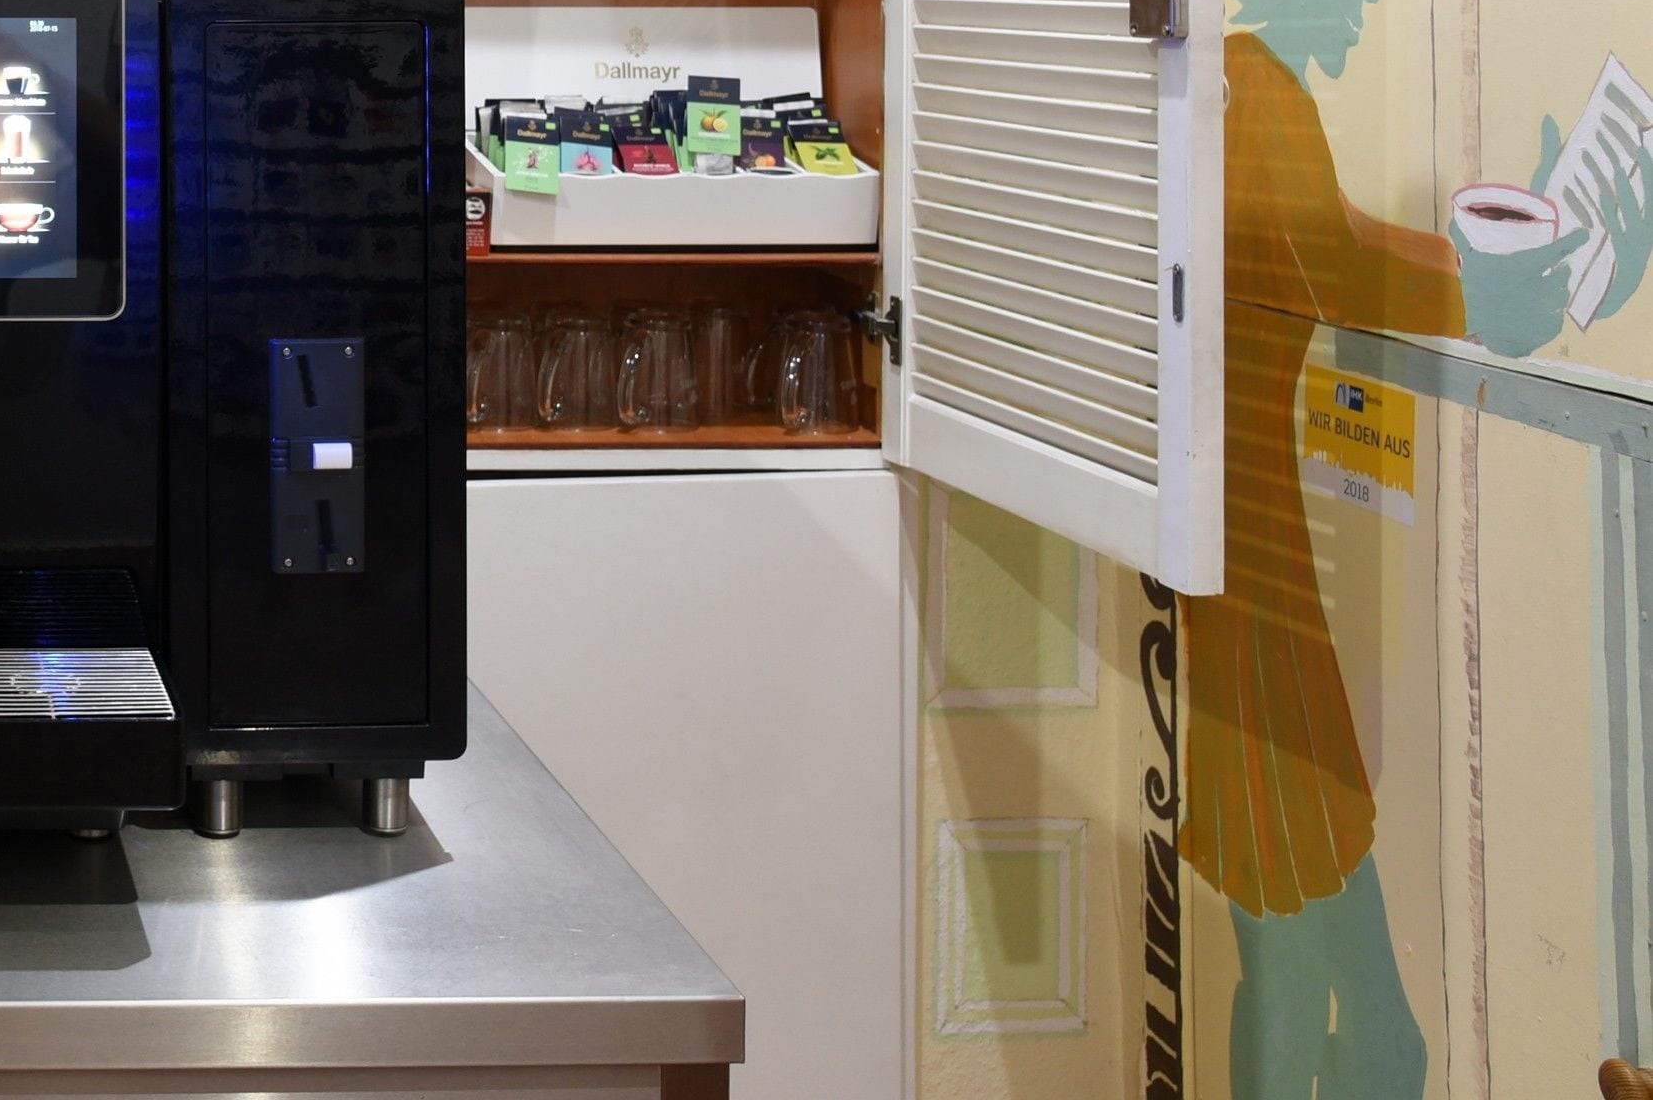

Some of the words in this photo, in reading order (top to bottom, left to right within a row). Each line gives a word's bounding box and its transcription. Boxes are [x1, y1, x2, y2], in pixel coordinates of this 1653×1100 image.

[594, 61, 681, 83] Dallmayr
[1308, 410, 1331, 431] WIR
[1334, 417, 1380, 449] BILDEN
[1384, 434, 1411, 458] AUS
[1343, 478, 1369, 502] 2018
